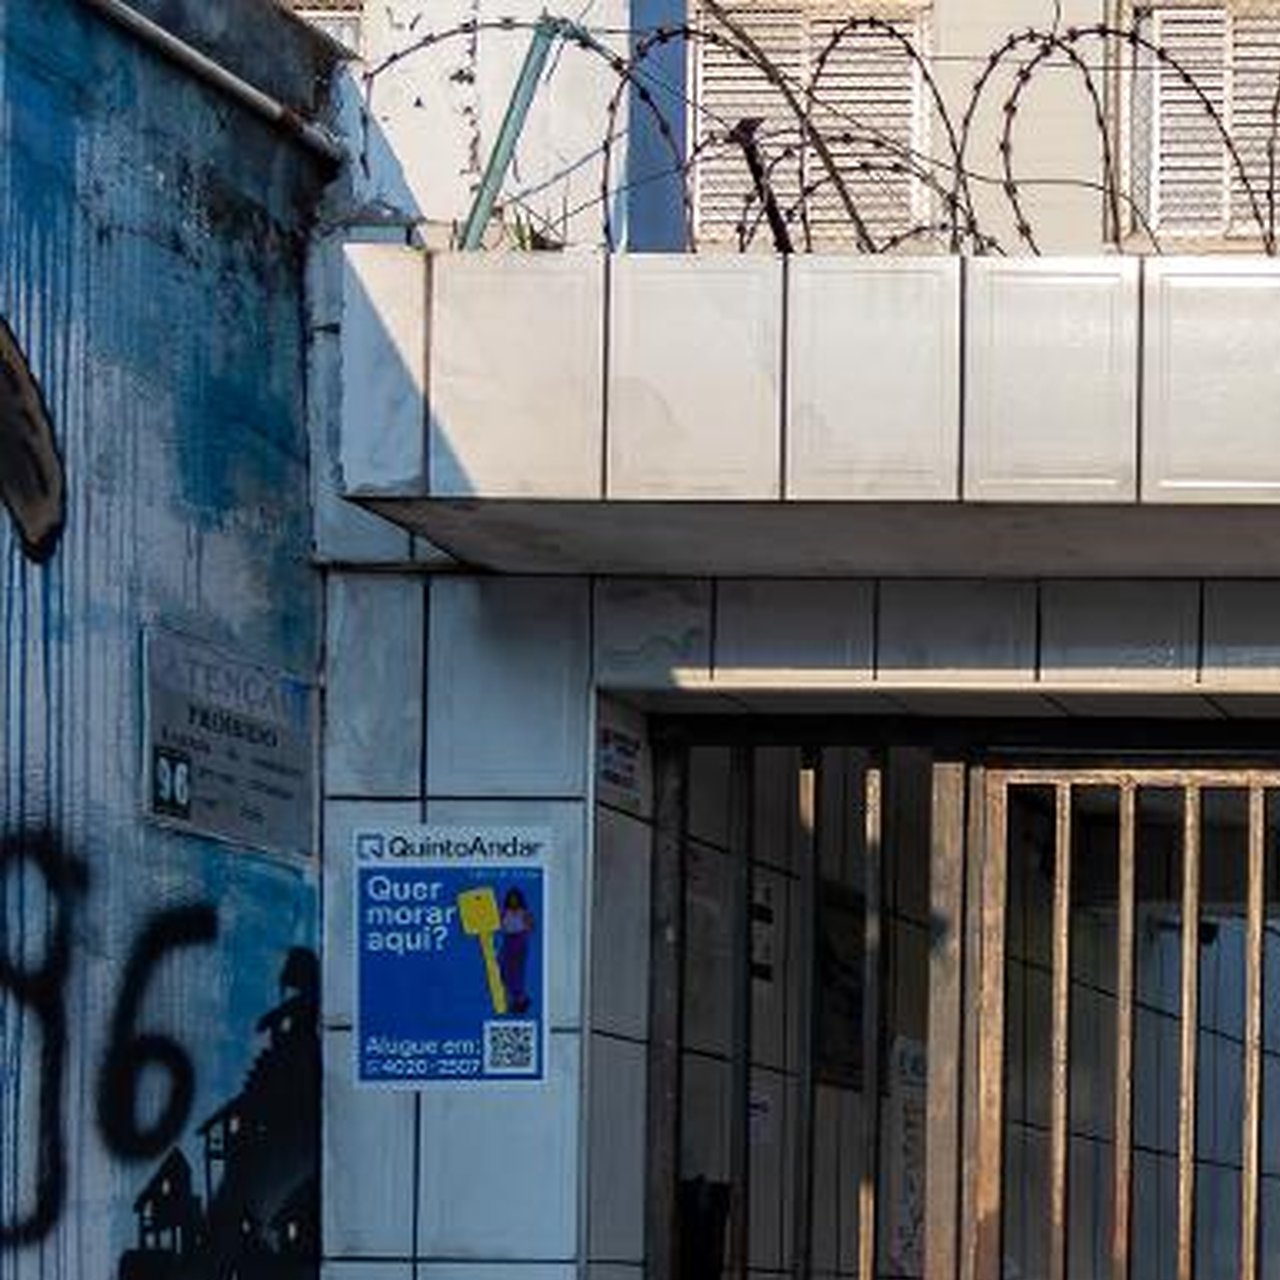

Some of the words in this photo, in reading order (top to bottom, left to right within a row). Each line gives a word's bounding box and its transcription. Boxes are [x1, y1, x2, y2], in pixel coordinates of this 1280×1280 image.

[388, 835, 545, 858] QuintoAndar
[368, 876, 443, 901] Quer
[367, 905, 457, 926] morar
[368, 926, 449, 954] aqui?
